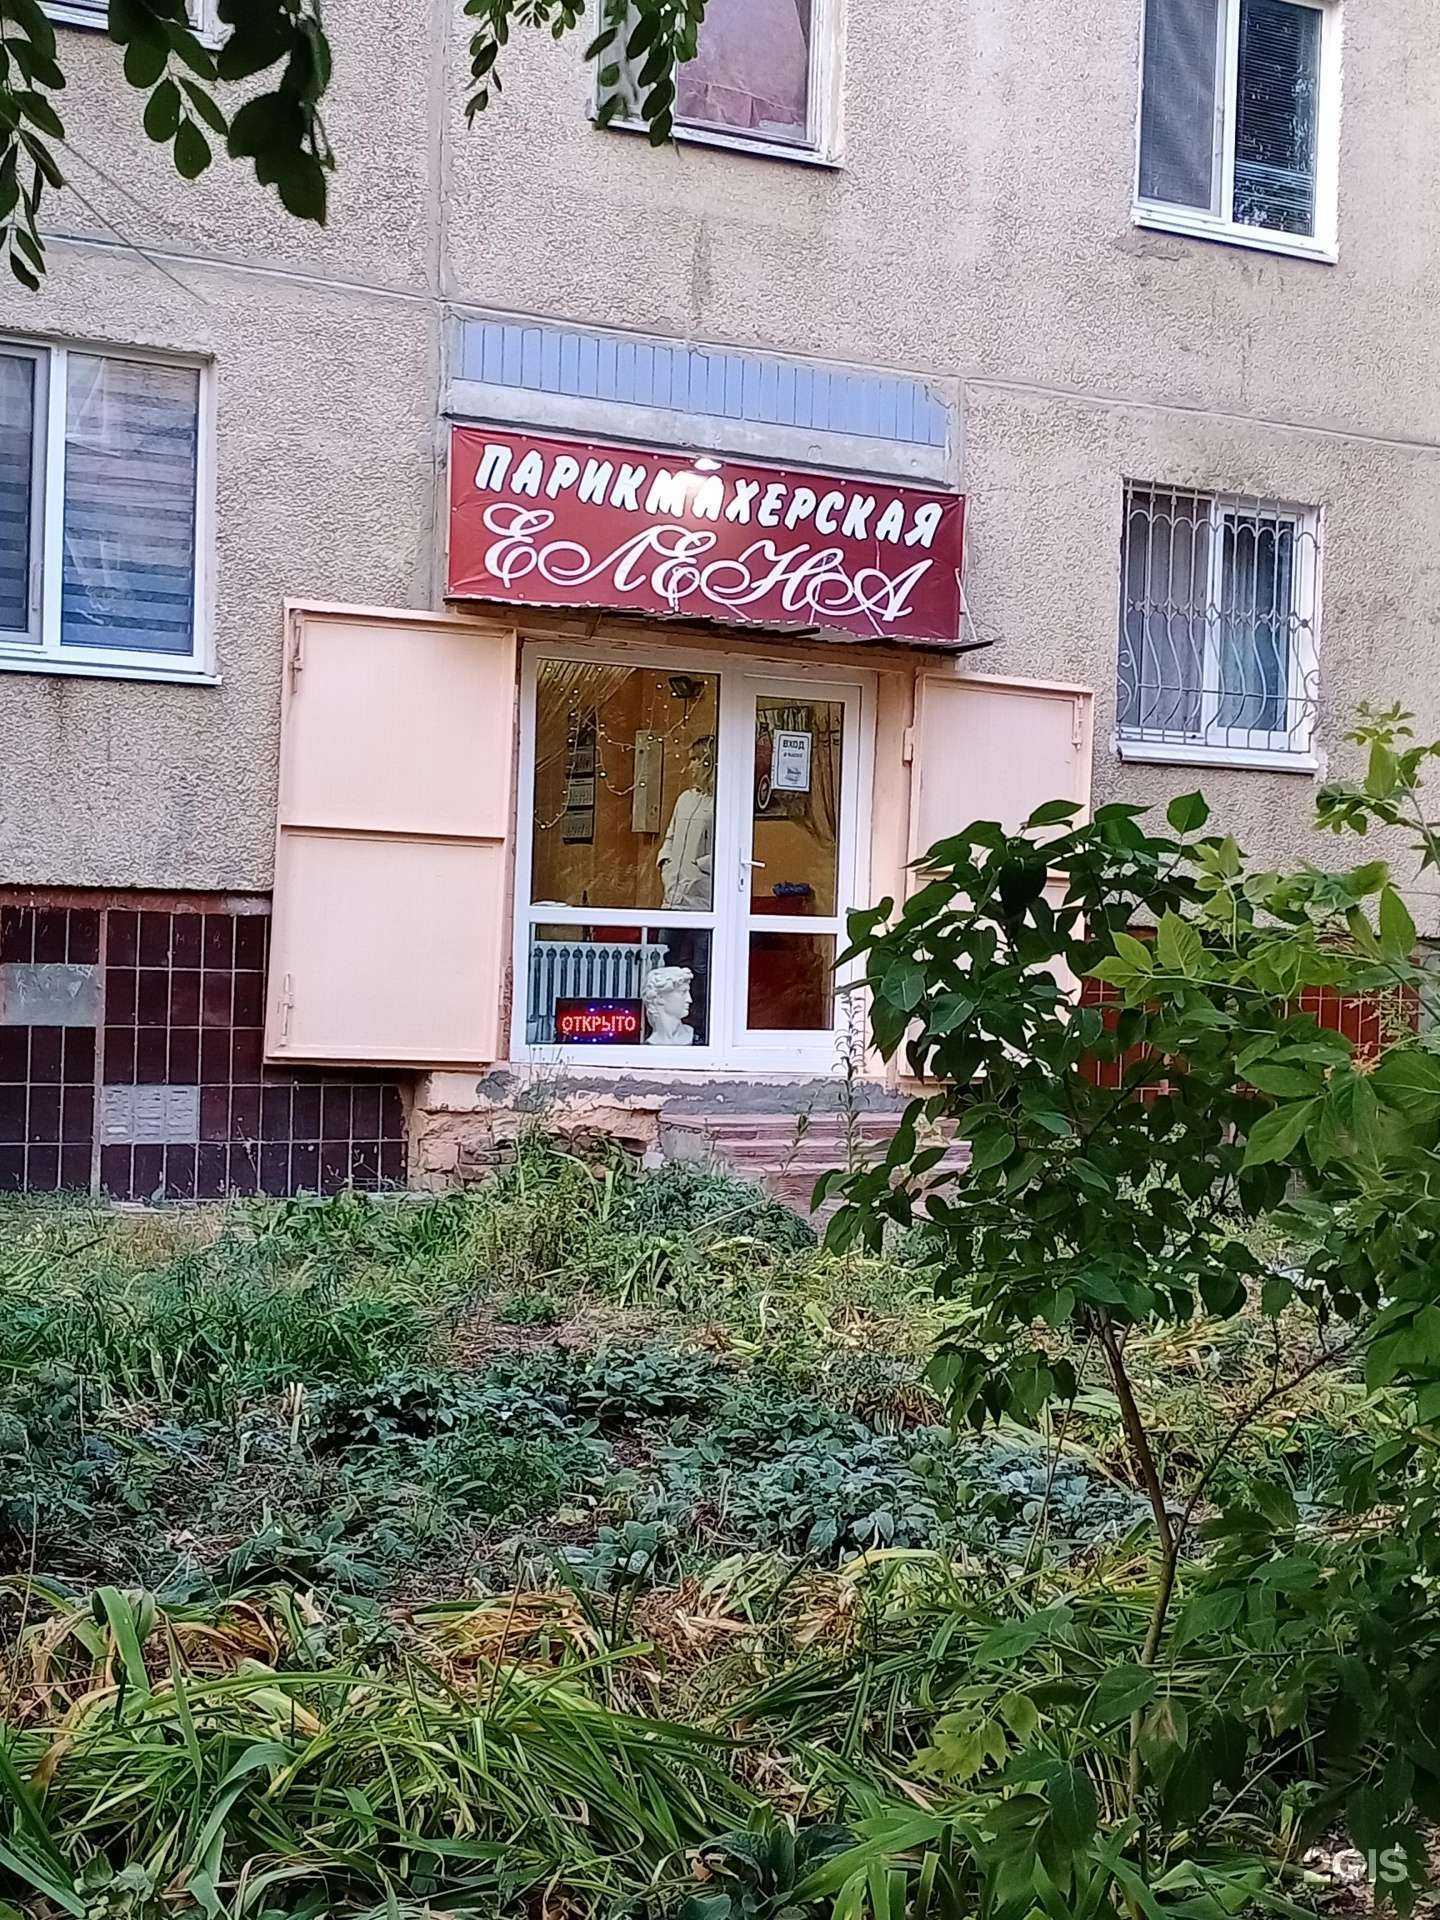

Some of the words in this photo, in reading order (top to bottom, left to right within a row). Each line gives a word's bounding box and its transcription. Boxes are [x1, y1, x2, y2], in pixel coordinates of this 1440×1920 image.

[474, 443, 944, 549] ПАРИКМАХЕРСКАЯ
[482, 502, 935, 622] ЕЛЕНА
[782, 739, 805, 750] ВХОД
[561, 1015, 636, 1032] ОТКРЫТО
